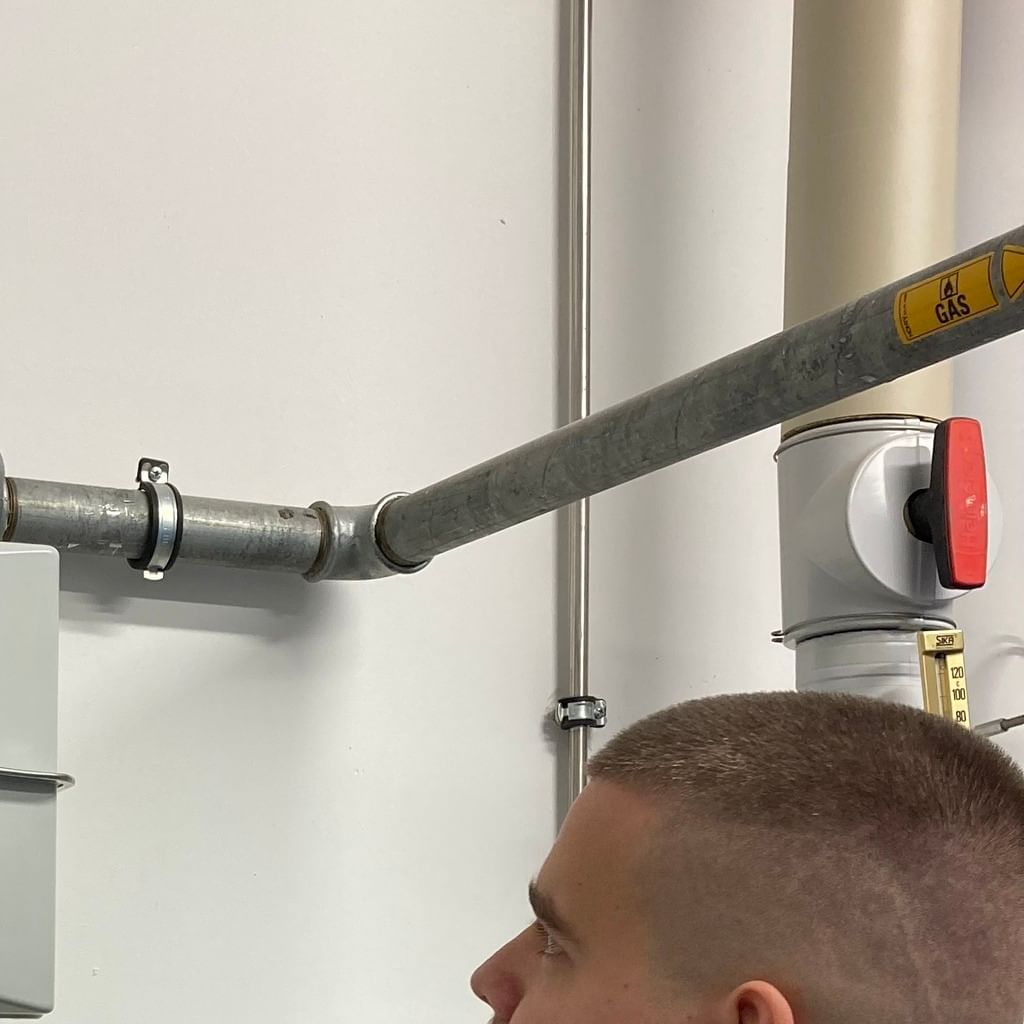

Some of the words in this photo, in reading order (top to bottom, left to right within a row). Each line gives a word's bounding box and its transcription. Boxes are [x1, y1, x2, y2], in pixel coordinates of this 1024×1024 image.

[935, 294, 971, 324] GAS
[936, 634, 955, 647] SIKA
[951, 666, 964, 679] 120
[952, 688, 966, 700] 100
[956, 710, 967, 722] 80
